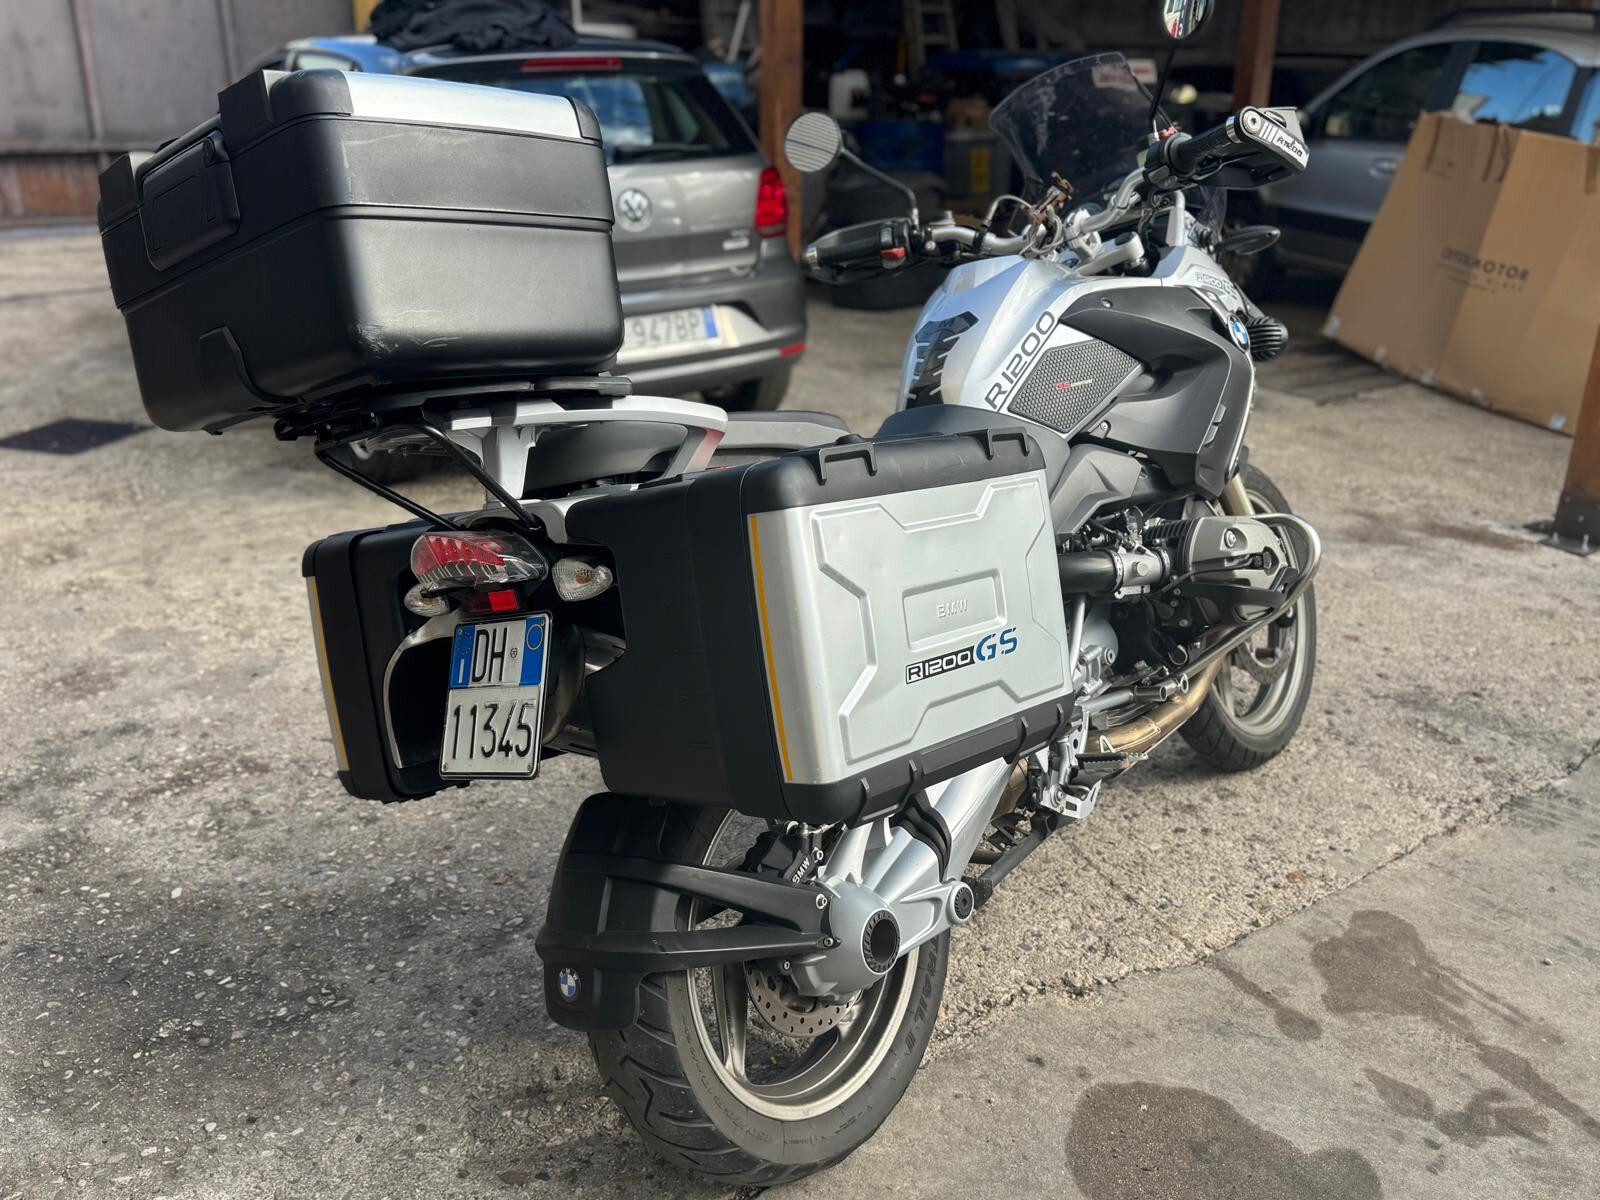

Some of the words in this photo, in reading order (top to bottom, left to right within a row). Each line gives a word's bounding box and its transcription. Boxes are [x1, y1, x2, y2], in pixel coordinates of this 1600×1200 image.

[984, 310, 1055, 410] R1200
[936, 598, 968, 618] BMW
[472, 627, 508, 683] DH
[906, 648, 972, 683] R1200
[975, 627, 1018, 661] GS
[451, 701, 534, 759] 11345
